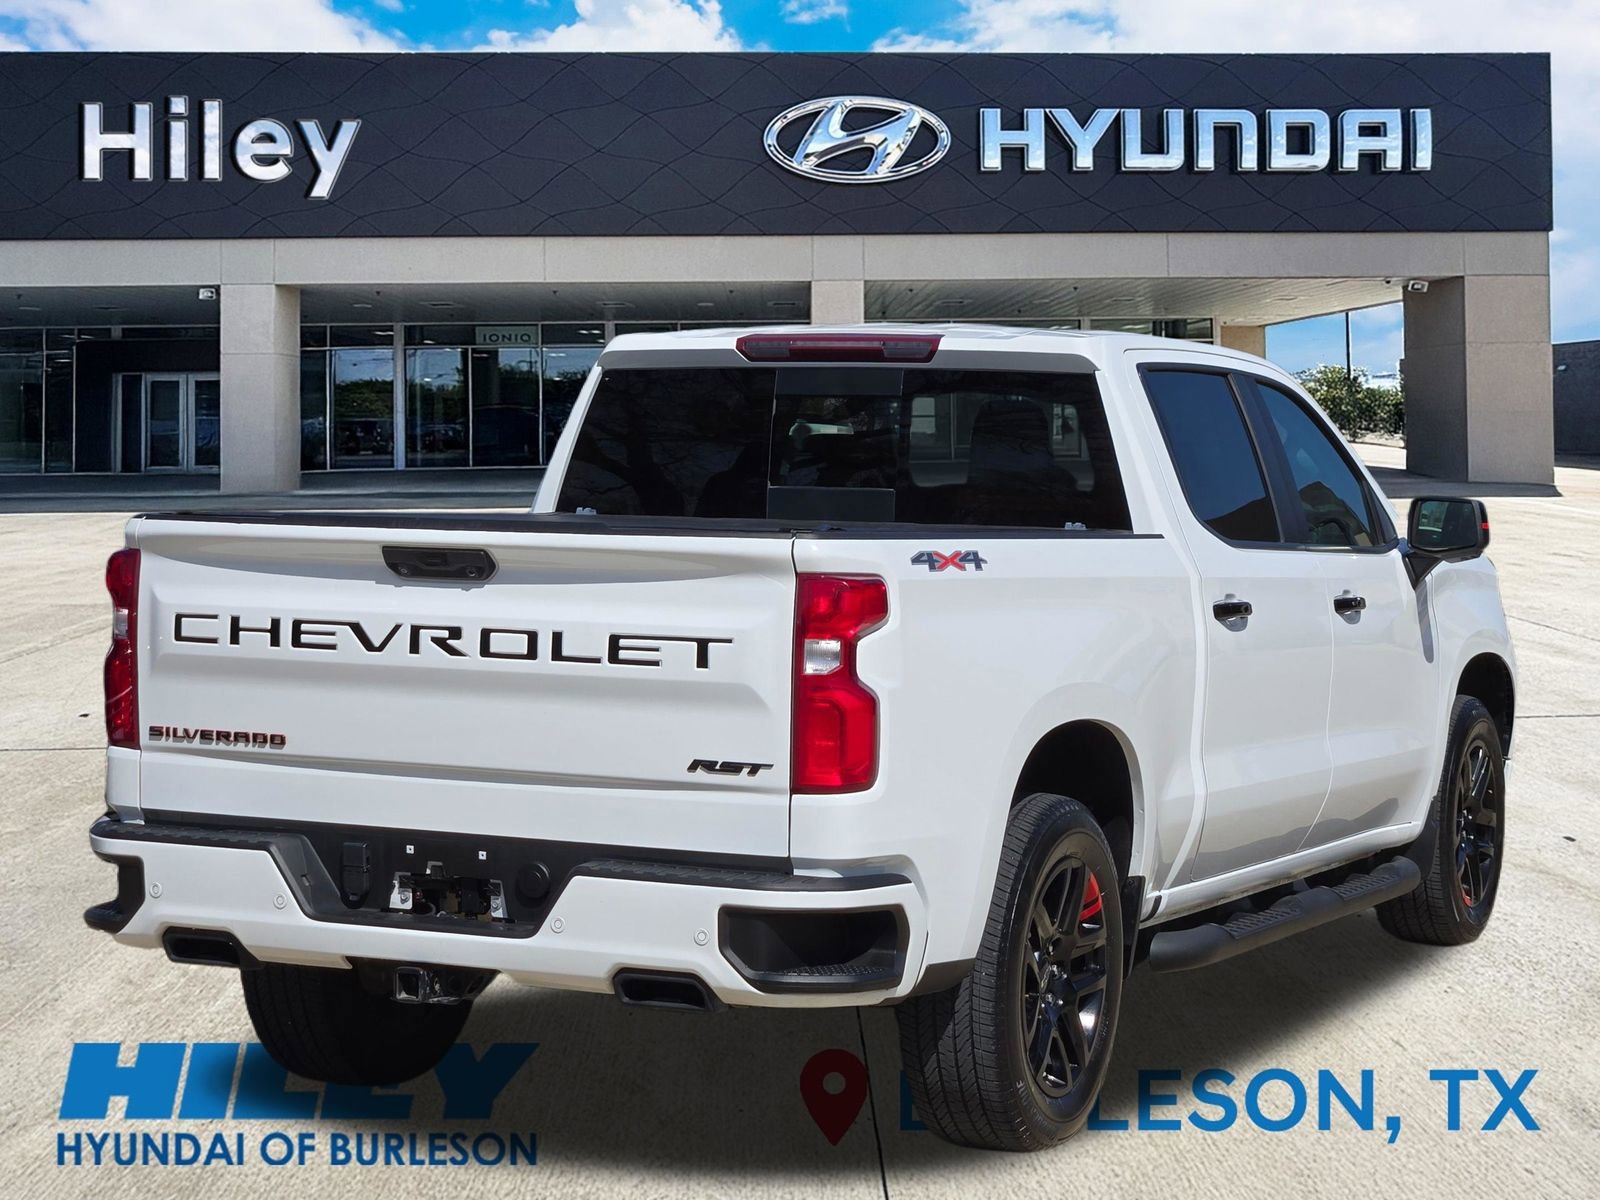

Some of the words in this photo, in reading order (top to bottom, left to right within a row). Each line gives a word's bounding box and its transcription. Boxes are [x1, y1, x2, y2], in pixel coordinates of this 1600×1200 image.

[80, 95, 361, 199] Hiley
[979, 107, 1433, 173] HYUNDAI
[173, 612, 734, 670] CHEVROLET
[148, 725, 287, 750] SILVERADO
[686, 758, 775, 777] RST
